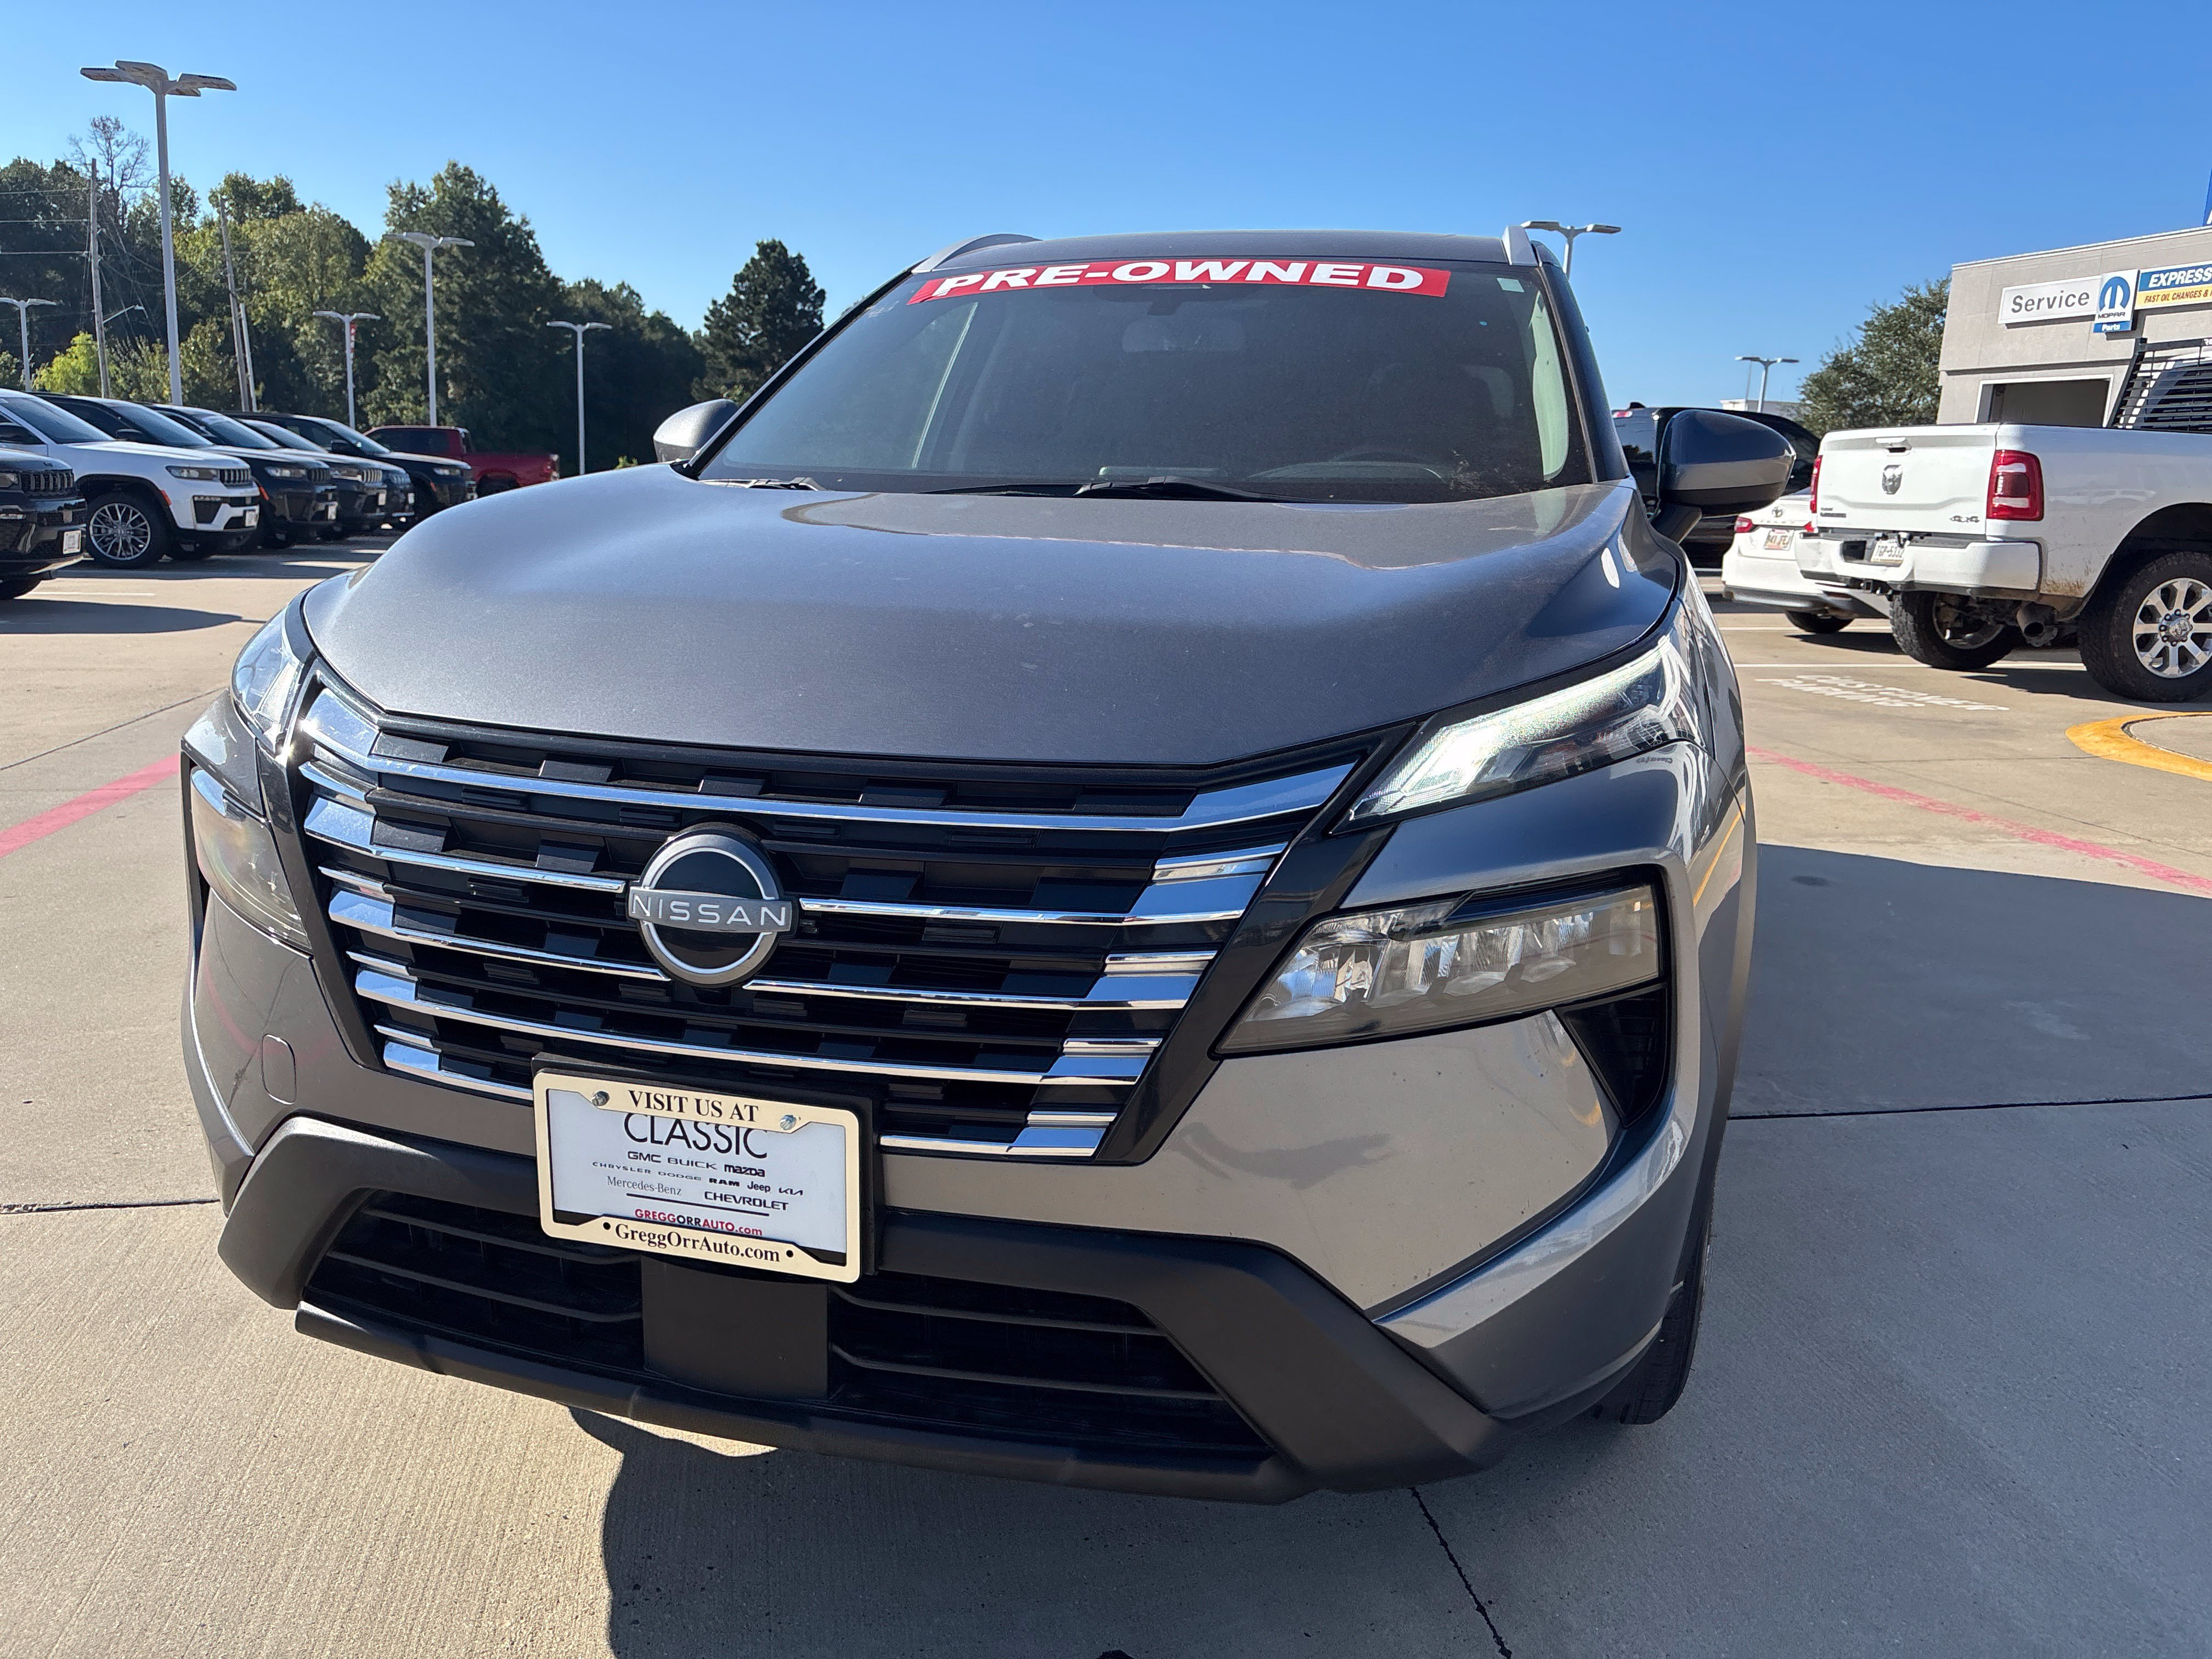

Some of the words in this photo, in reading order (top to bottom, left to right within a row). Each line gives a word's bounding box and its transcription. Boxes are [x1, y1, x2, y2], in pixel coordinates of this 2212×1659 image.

[934, 261, 1424, 296] PRE-OWNED
[2148, 267, 2212, 287] EXPRESS
[2011, 290, 2090, 313] Service
[2144, 294, 2160, 303] FAST
[2171, 290, 2202, 300] CHANGES
[632, 895, 786, 926] NISSAN
[628, 1090, 689, 1113] VISIT
[695, 1098, 723, 1118] US
[729, 1103, 759, 1122] AT
[624, 1113, 768, 1159] CLASSIC
[628, 1151, 661, 1163] GMC
[667, 1158, 718, 1170] BUICK
[592, 1162, 651, 1174] CHRYSLER
[658, 1171, 702, 1181] DODGE
[709, 1178, 740, 1187] RAM
[747, 1181, 771, 1193] Jeep
[607, 1176, 682, 1196] Mercedes-Benz
[704, 1191, 789, 1211] CHEVROLET
[635, 1209, 762, 1236] GREGGORRAUTO.com
[615, 1223, 780, 1262] GreggOrrAuto.com
